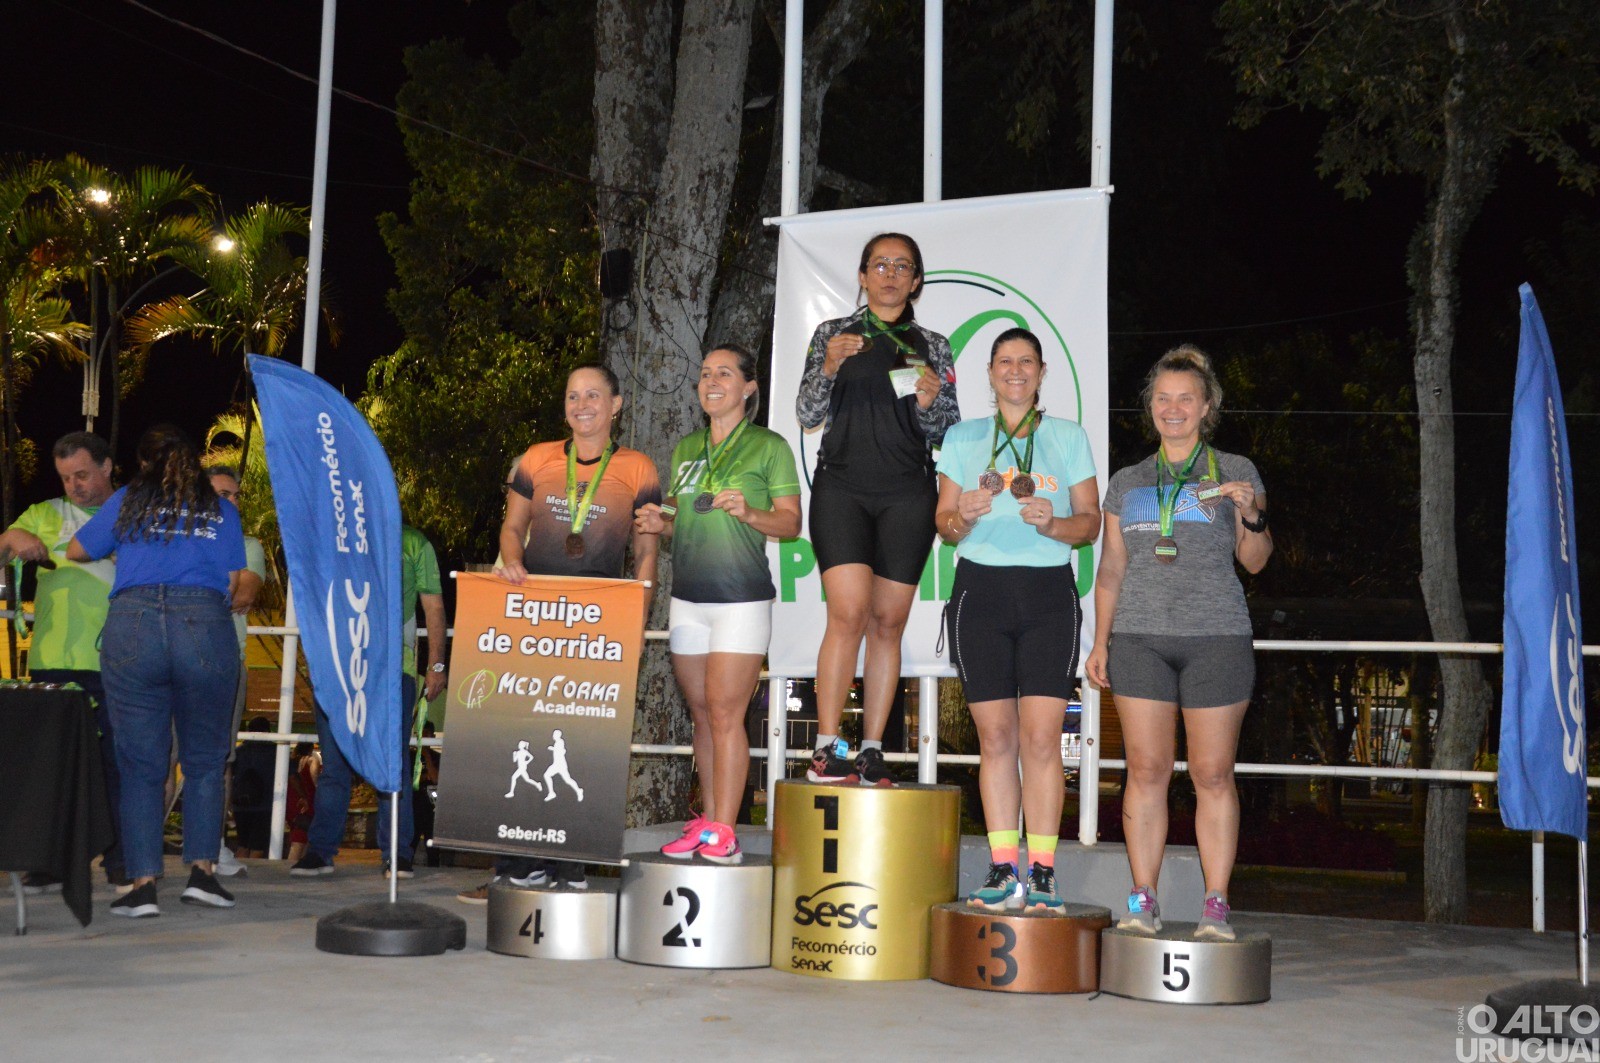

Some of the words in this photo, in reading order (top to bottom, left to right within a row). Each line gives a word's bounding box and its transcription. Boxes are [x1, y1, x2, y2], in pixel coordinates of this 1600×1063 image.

[316, 412, 350, 553] Fecomércio
[545, 495, 568, 506] Med
[348, 479, 369, 555] Senac
[551, 506, 598, 520] Acaia
[505, 592, 602, 628] Equipe
[345, 578, 370, 738] Sesc
[477, 627, 512, 654] de
[519, 633, 623, 662] corrida
[533, 699, 616, 719] Academia
[498, 824, 567, 844] Seberi-RS
[814, 795, 839, 873] 1
[518, 908, 545, 945] 4
[662, 886, 702, 948] 2
[793, 895, 879, 930] Sesc
[791, 936, 877, 956] Fecomércio
[791, 955, 833, 973] Senac
[976, 921, 1019, 987] 3
[1162, 952, 1190, 992] 5
